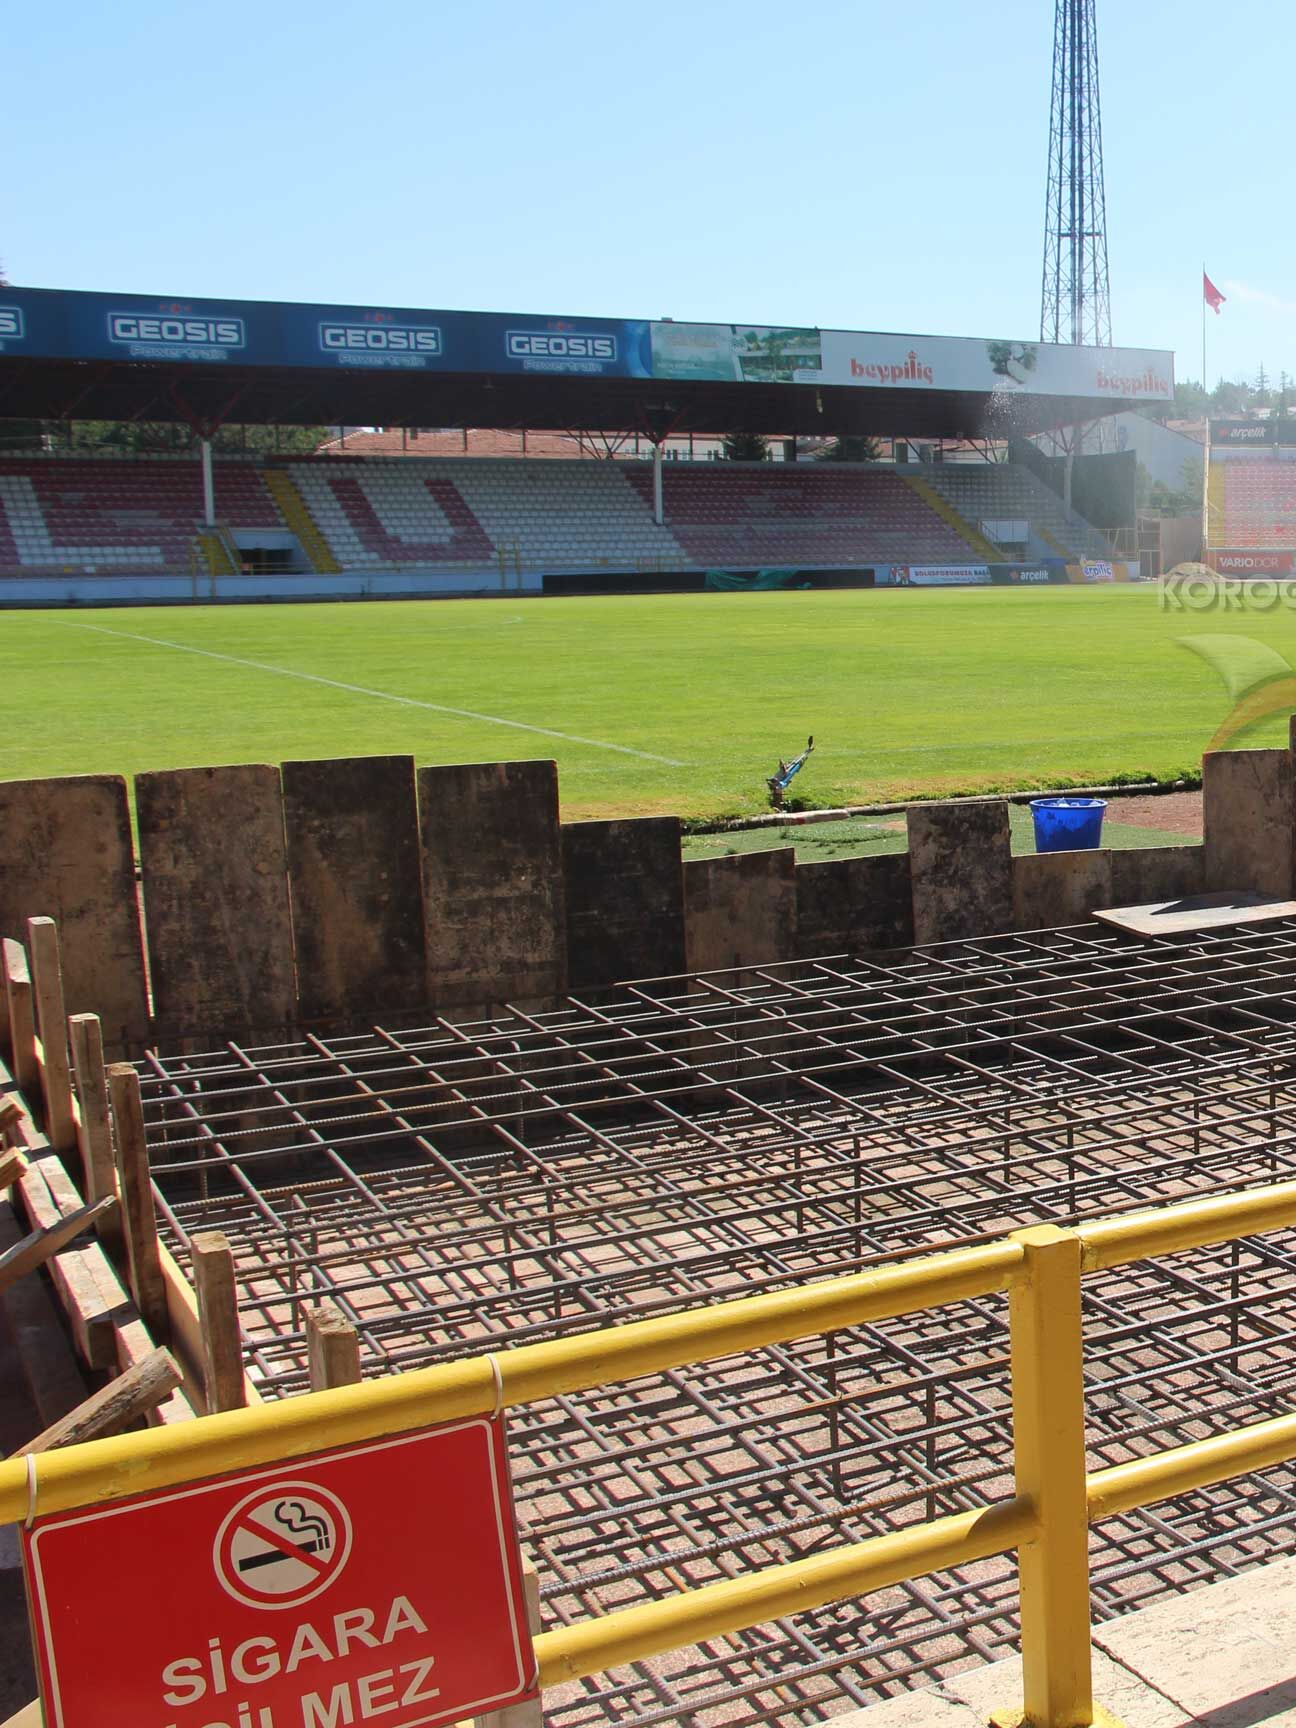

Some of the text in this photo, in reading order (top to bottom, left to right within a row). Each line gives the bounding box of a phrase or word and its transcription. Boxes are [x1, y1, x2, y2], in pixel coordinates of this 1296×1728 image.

[113, 318, 240, 343] GEOSIS
[323, 327, 438, 350] GEOSIS
[510, 336, 613, 357] GEOSIS
[161, 1595, 428, 1706] SİGARA
